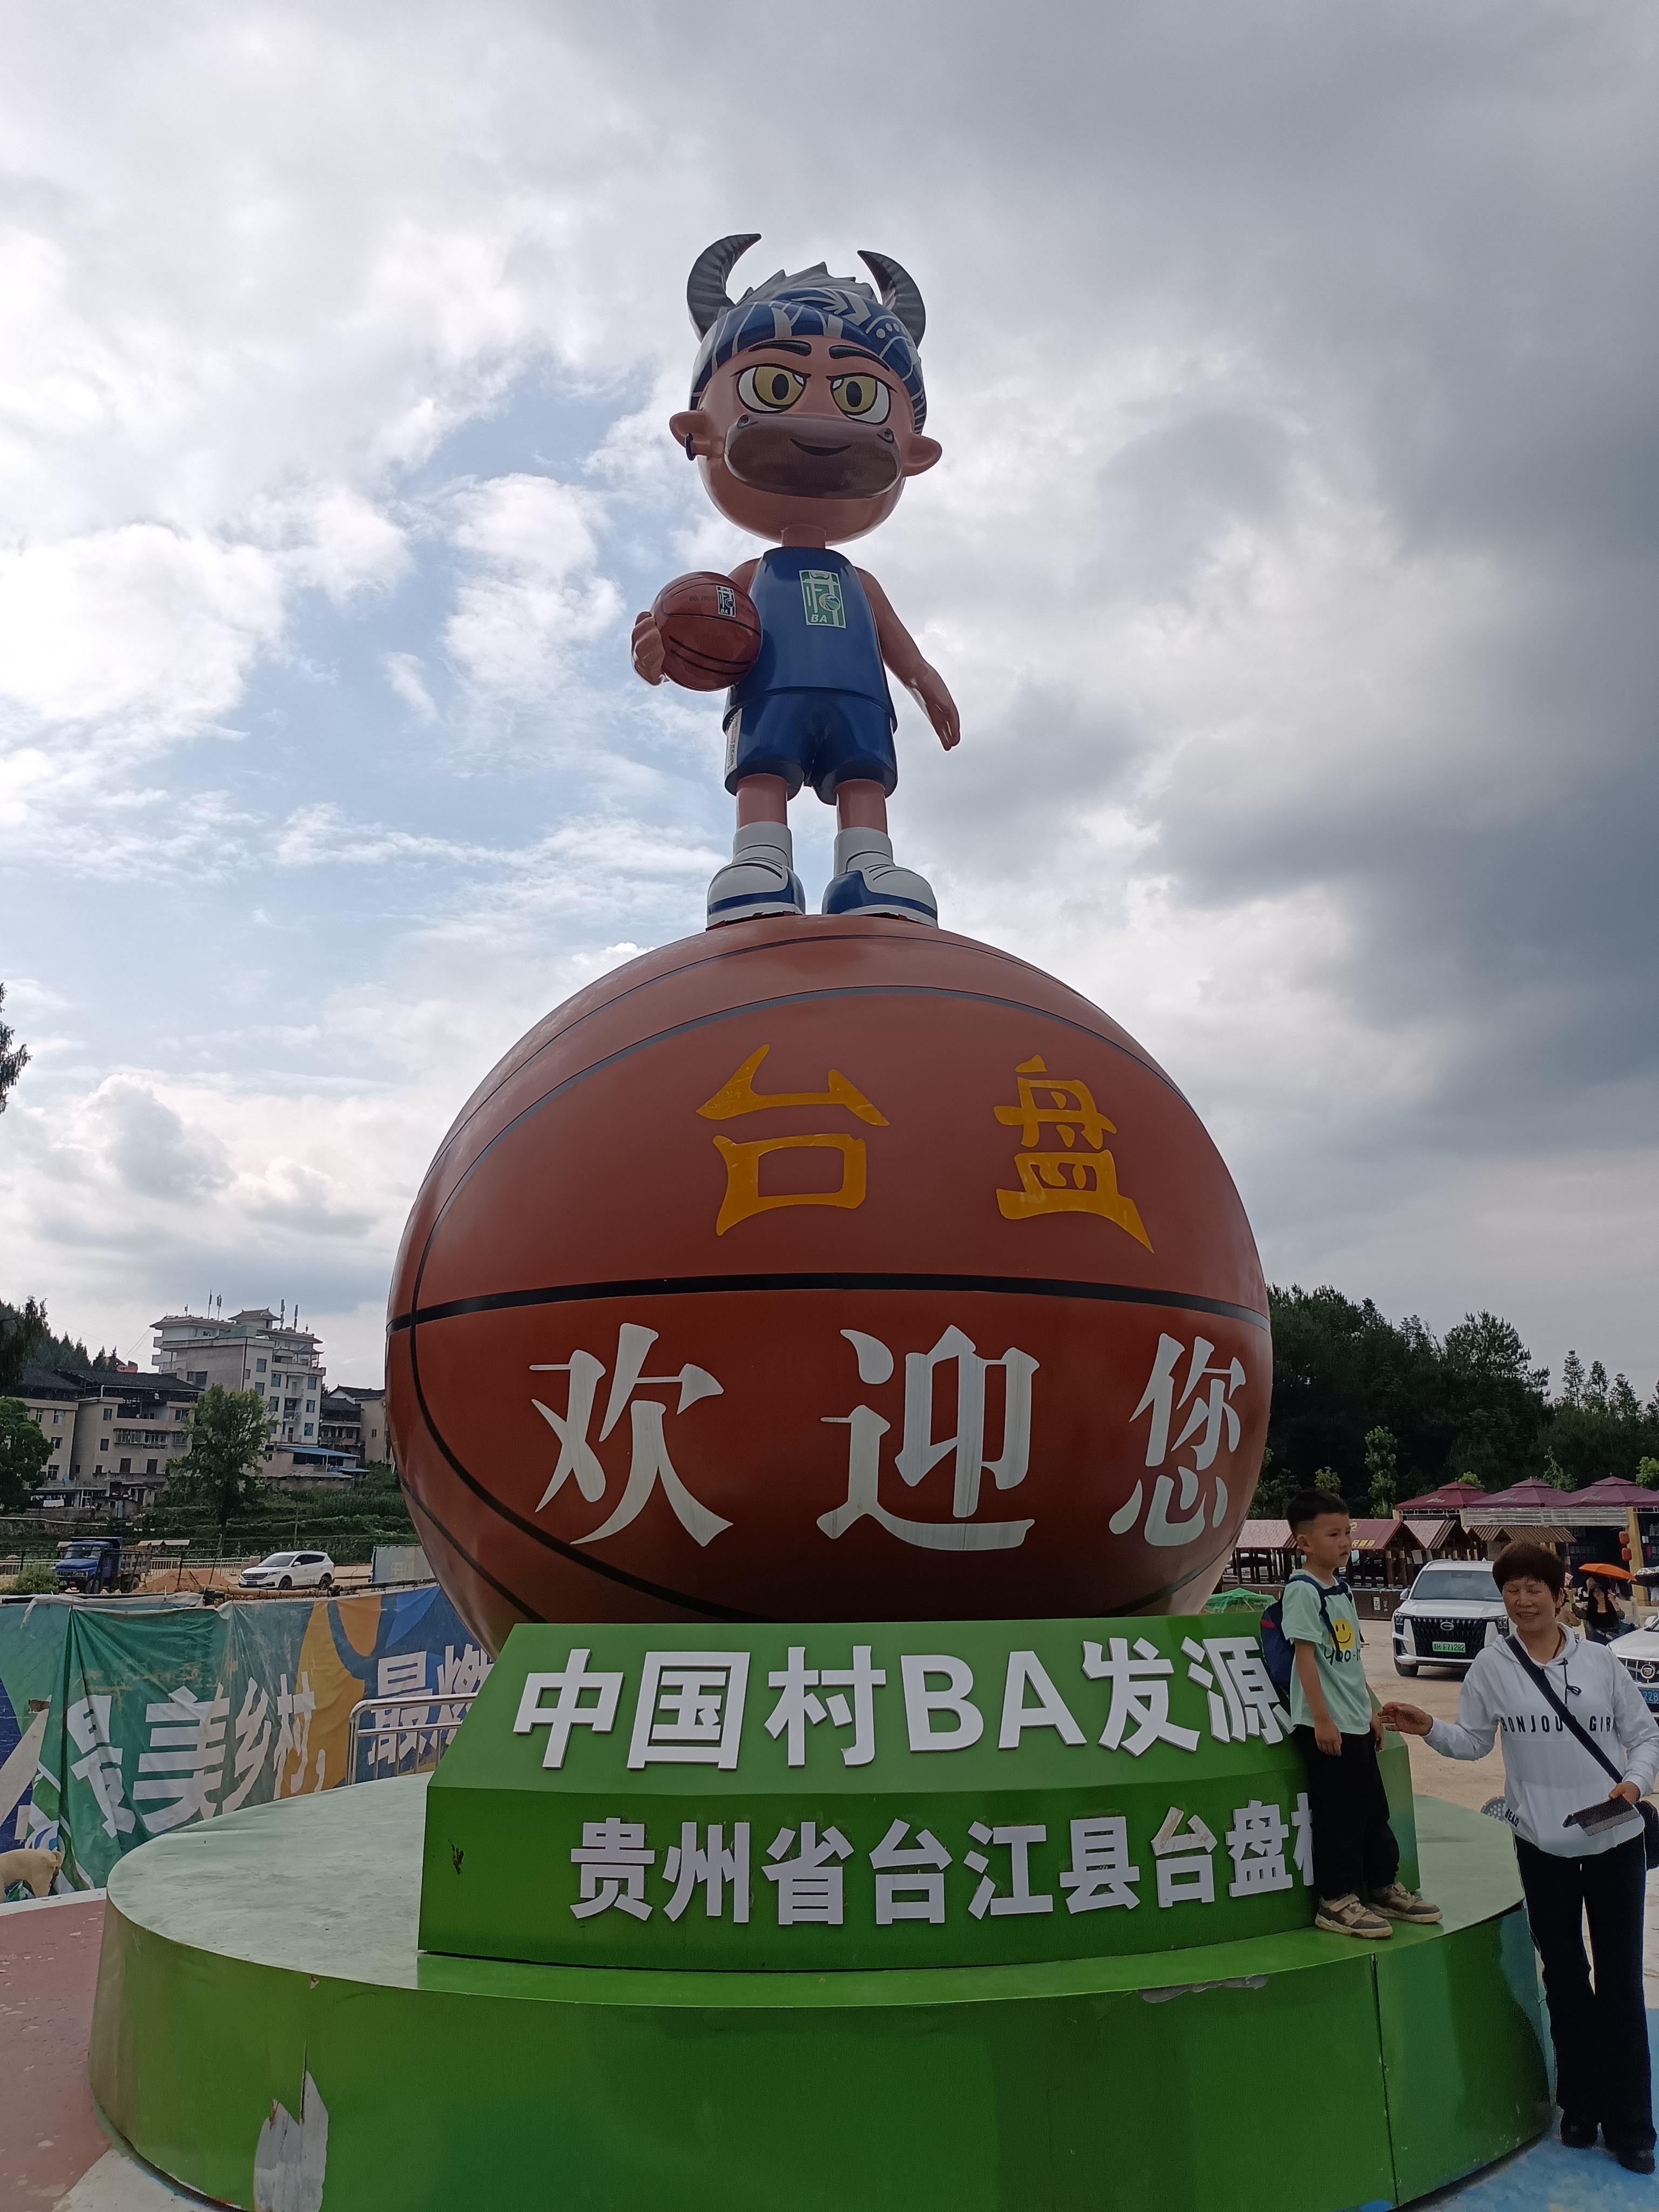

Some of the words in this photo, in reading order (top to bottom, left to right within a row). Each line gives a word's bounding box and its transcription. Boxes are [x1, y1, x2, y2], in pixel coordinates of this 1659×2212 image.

[811, 614, 828, 623] BA
[696, 1043, 1155, 1255] 台盘
[529, 1322, 1246, 1551] 欢迎您
[1500, 1714, 1577, 1733] BONJOU
